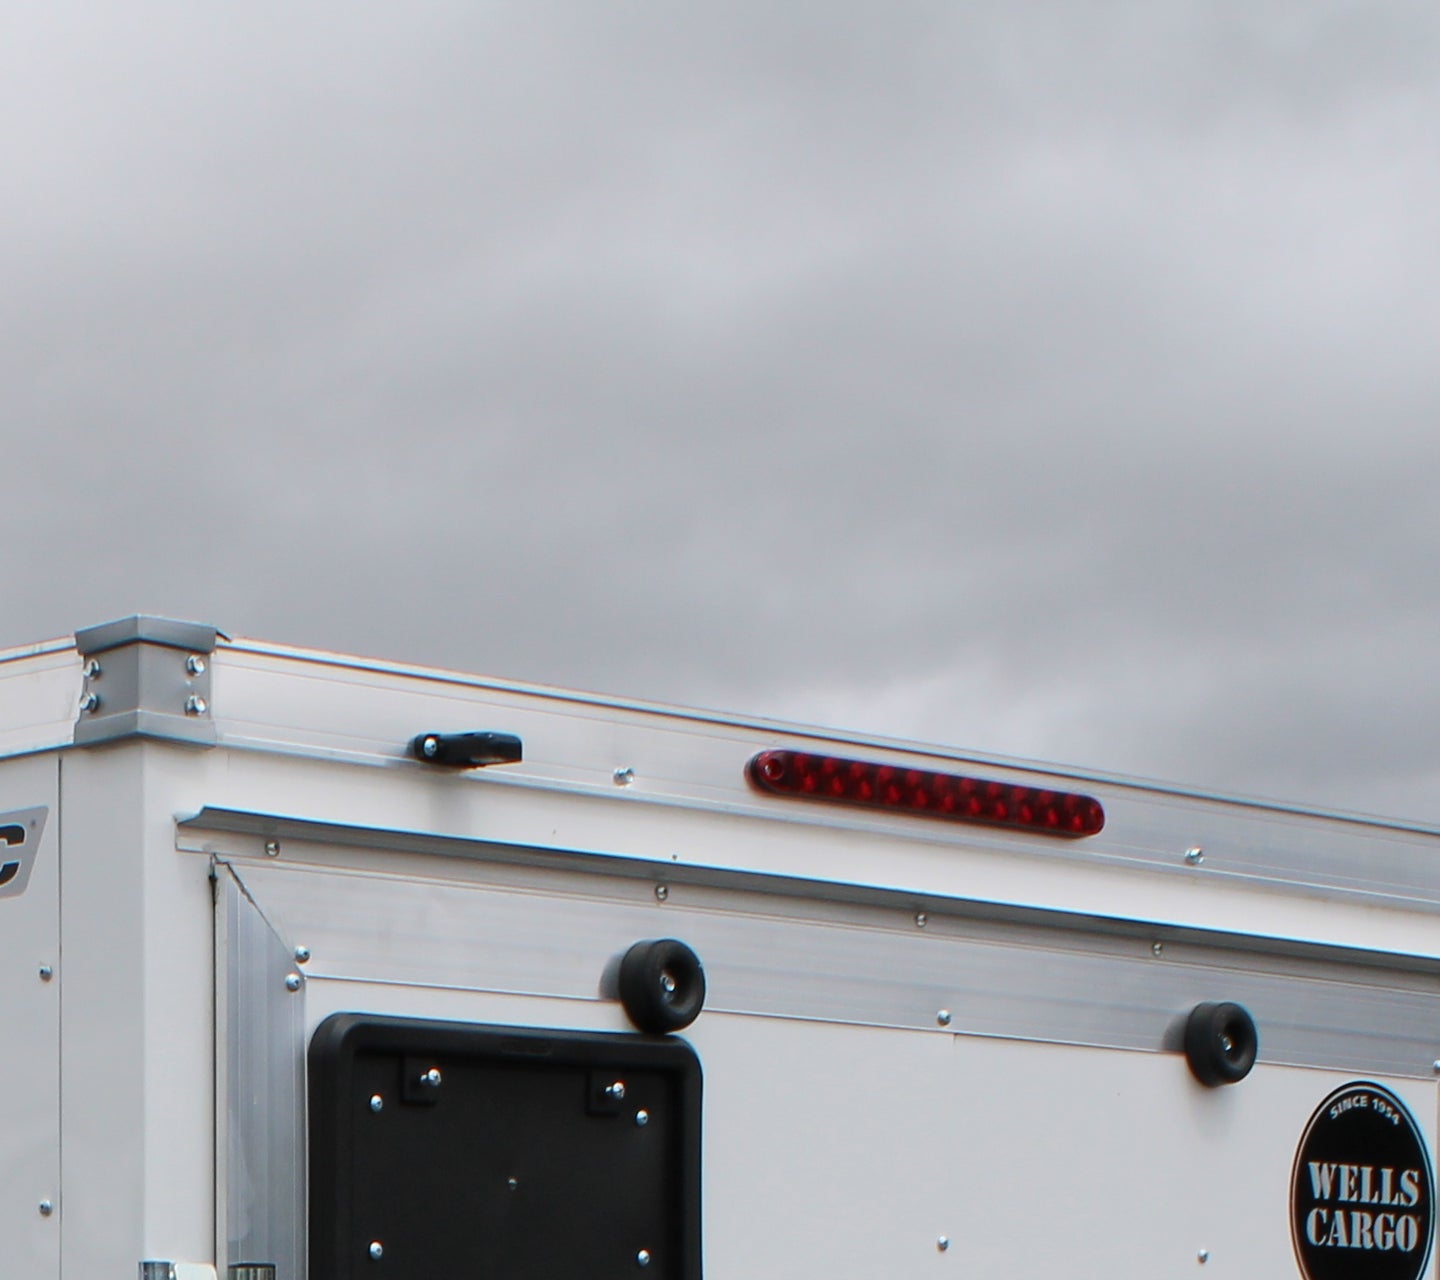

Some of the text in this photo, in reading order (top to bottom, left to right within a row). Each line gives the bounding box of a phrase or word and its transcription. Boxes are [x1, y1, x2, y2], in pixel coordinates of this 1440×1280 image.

[1330, 1095, 1401, 1125] SINCE 1954
[1308, 1161, 1420, 1207] WELLS
[1306, 1207, 1418, 1252] CARGO
